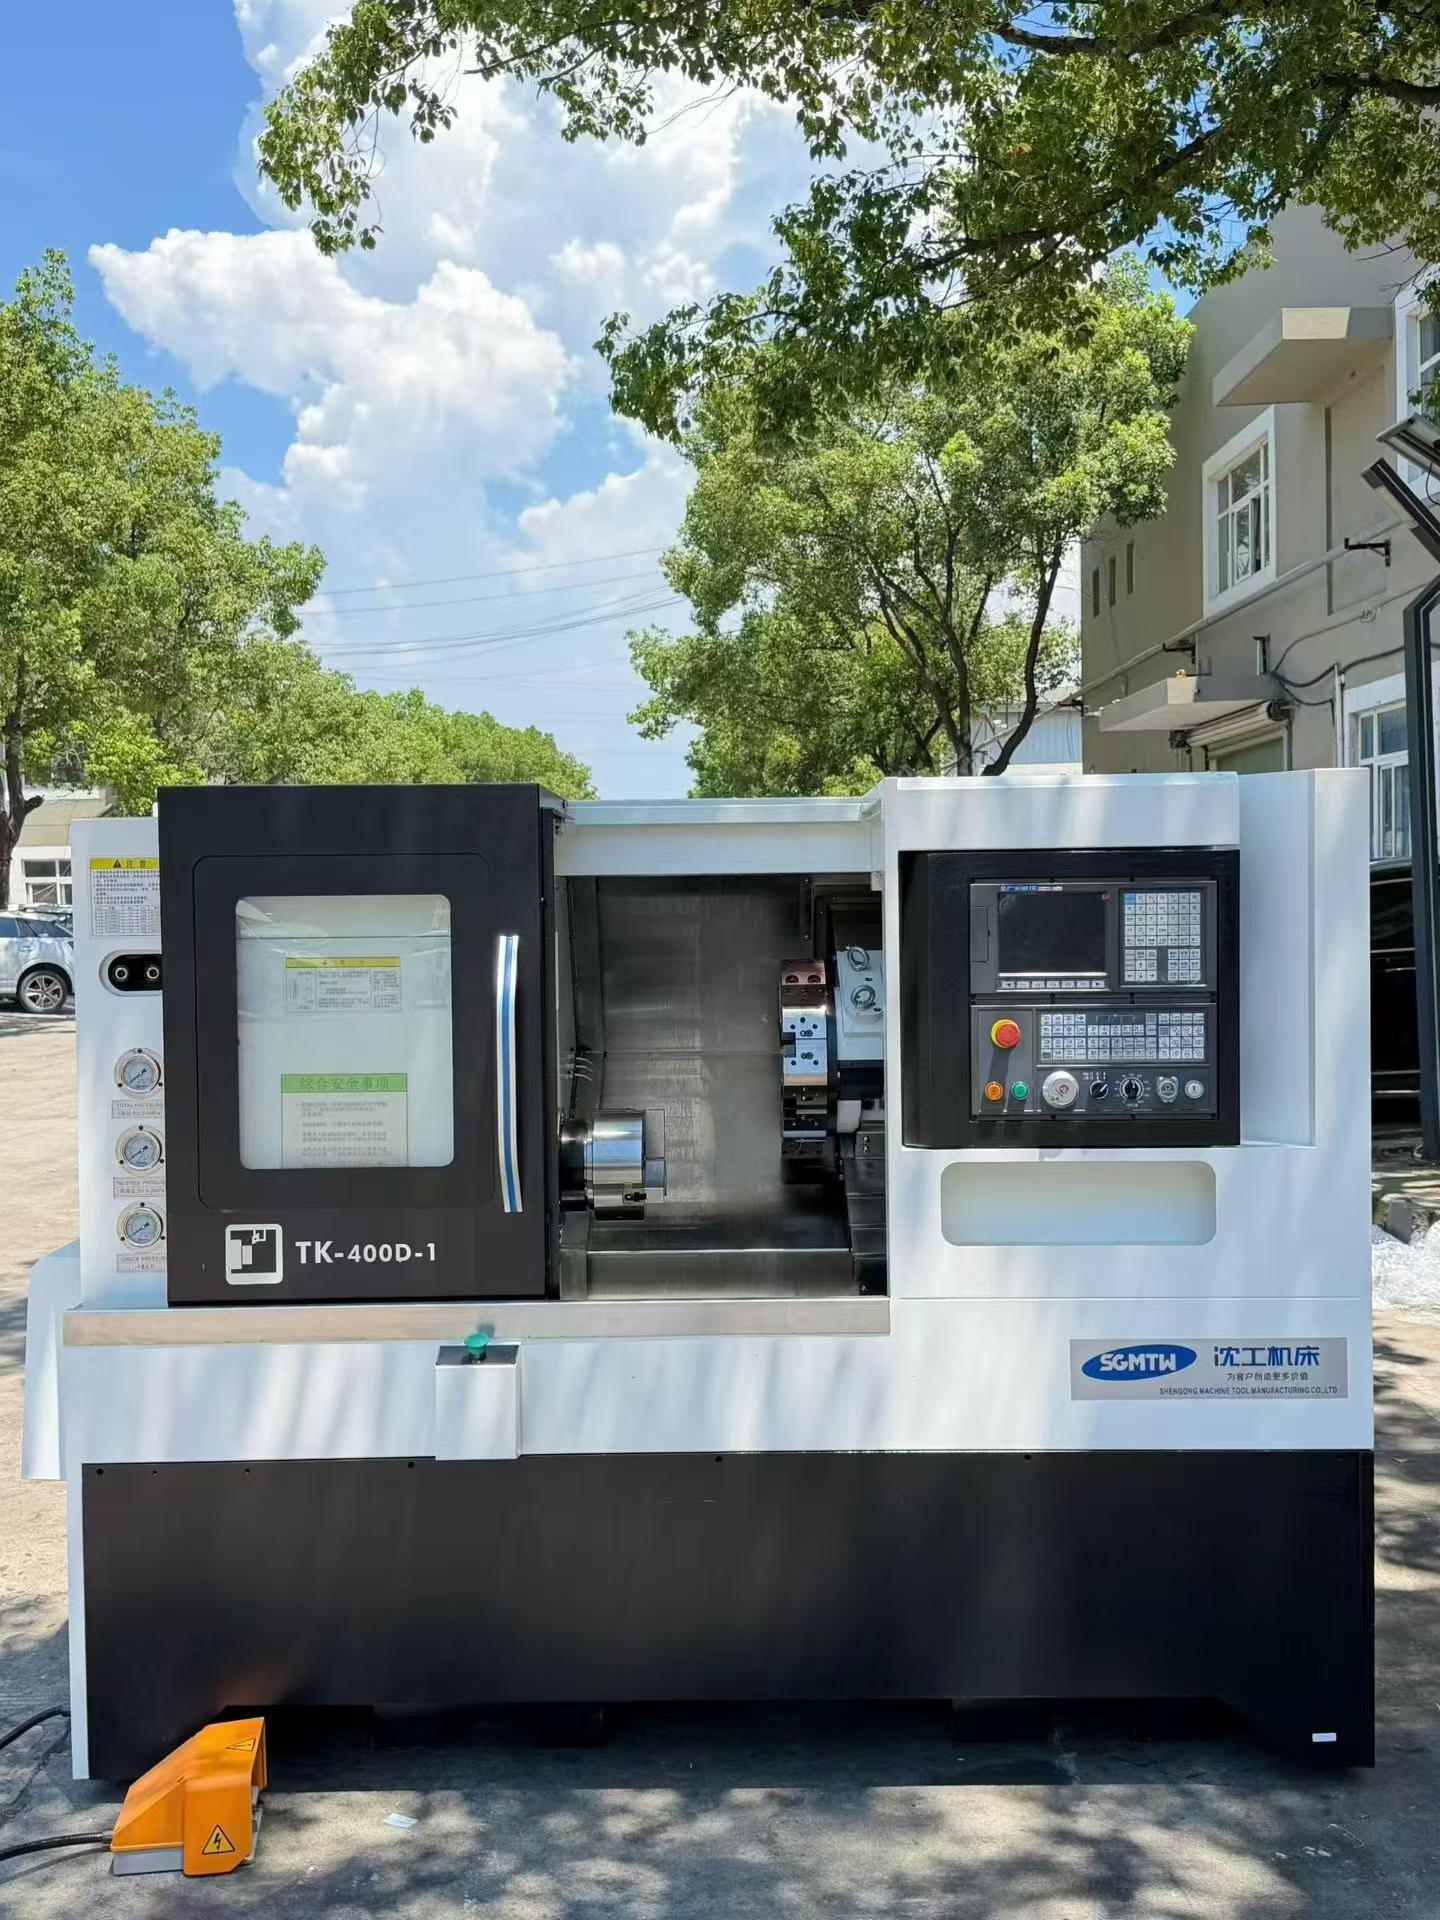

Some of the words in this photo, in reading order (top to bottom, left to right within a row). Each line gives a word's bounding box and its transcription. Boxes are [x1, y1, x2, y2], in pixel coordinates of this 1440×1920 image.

[295, 1240, 436, 1264] TK-400D-1
[1100, 1353, 1177, 1371] SGMTW
[1214, 1345, 1320, 1367] 沈工机床
[1227, 1372, 1309, 1381] 为客户创造更多价值
[1159, 1387, 1198, 1396] SHENGONG
[1199, 1387, 1230, 1395] MACHINE
[1232, 1387, 1250, 1395] TOOL
[1251, 1386, 1310, 1395] MANUFACTURING
